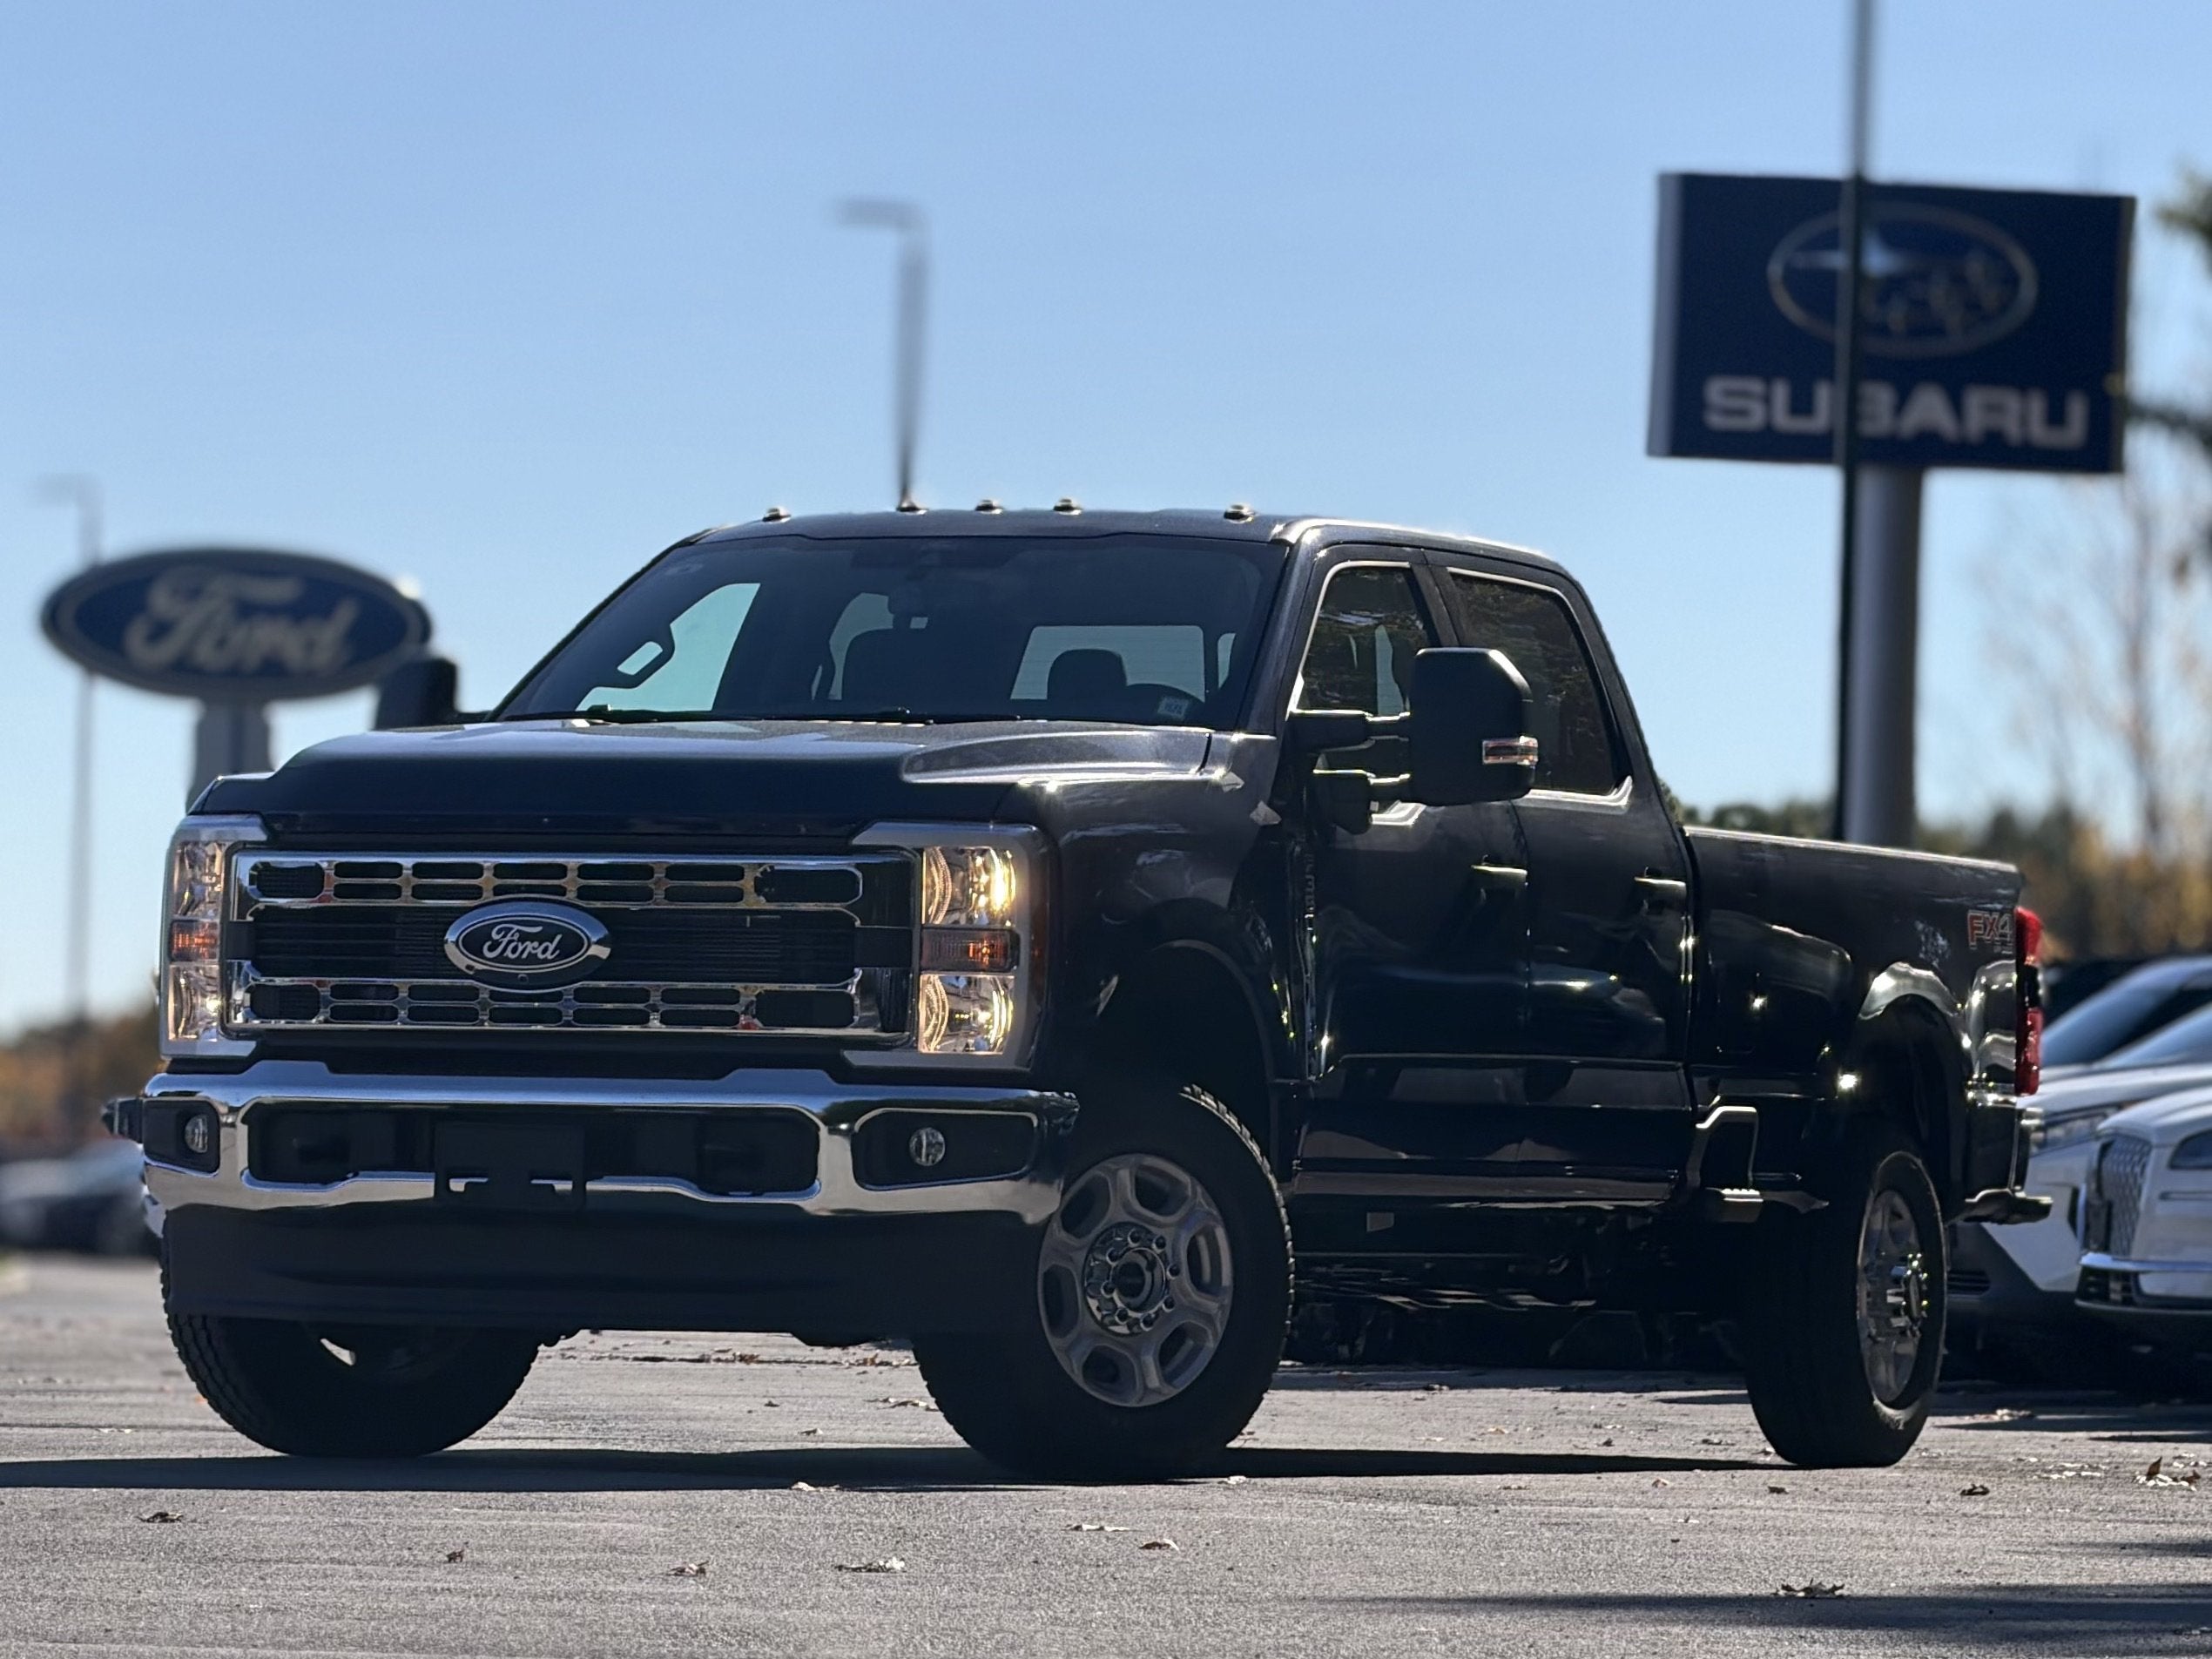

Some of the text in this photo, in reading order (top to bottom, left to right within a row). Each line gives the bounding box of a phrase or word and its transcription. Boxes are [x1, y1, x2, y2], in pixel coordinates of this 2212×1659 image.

[1703, 376, 2089, 449] SUBARU
[125, 564, 358, 673] Ford
[482, 924, 562, 960] Ford
[1967, 909, 2013, 949] FX4
